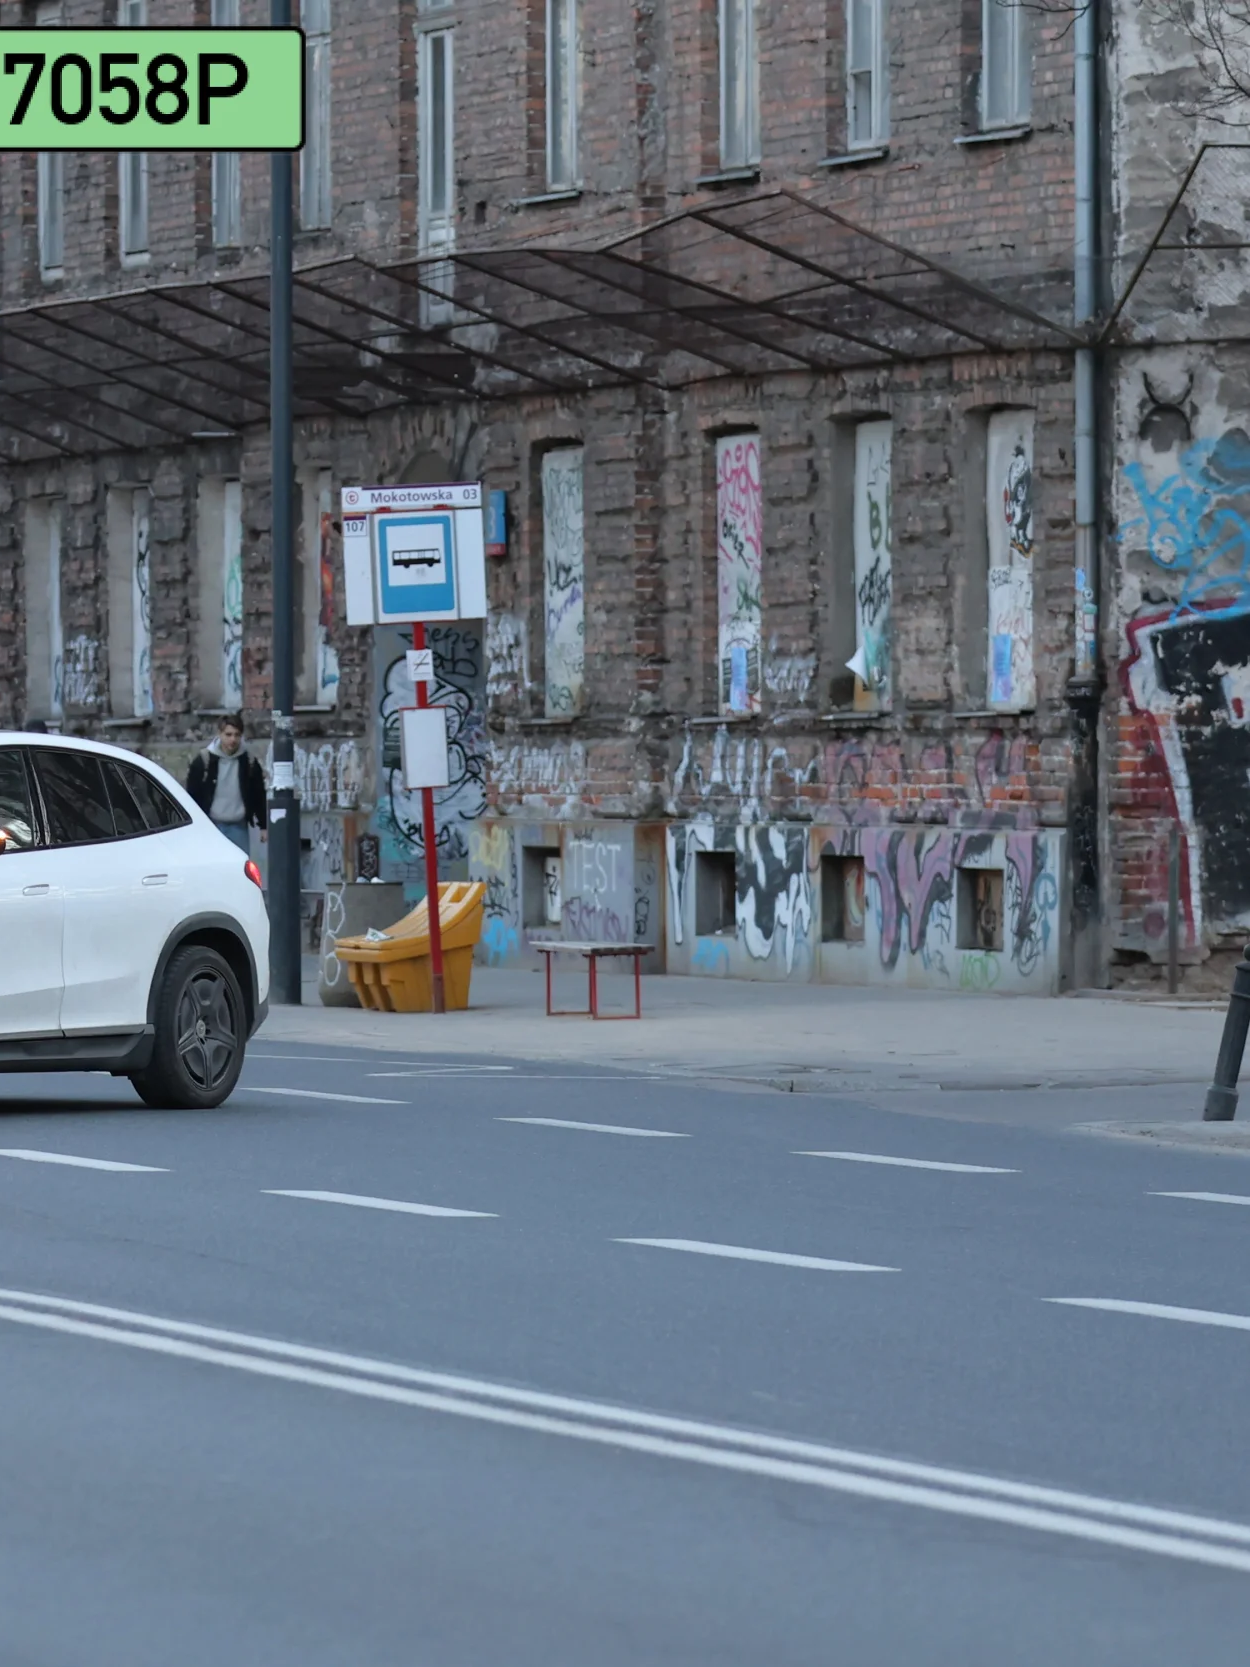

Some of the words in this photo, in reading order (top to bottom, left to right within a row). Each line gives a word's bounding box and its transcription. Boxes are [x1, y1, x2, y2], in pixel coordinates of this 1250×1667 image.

[370, 489, 454, 504] Mokotowska
[462, 488, 478, 500] 03
[345, 521, 365, 532] 107
[570, 841, 622, 894] TEST
